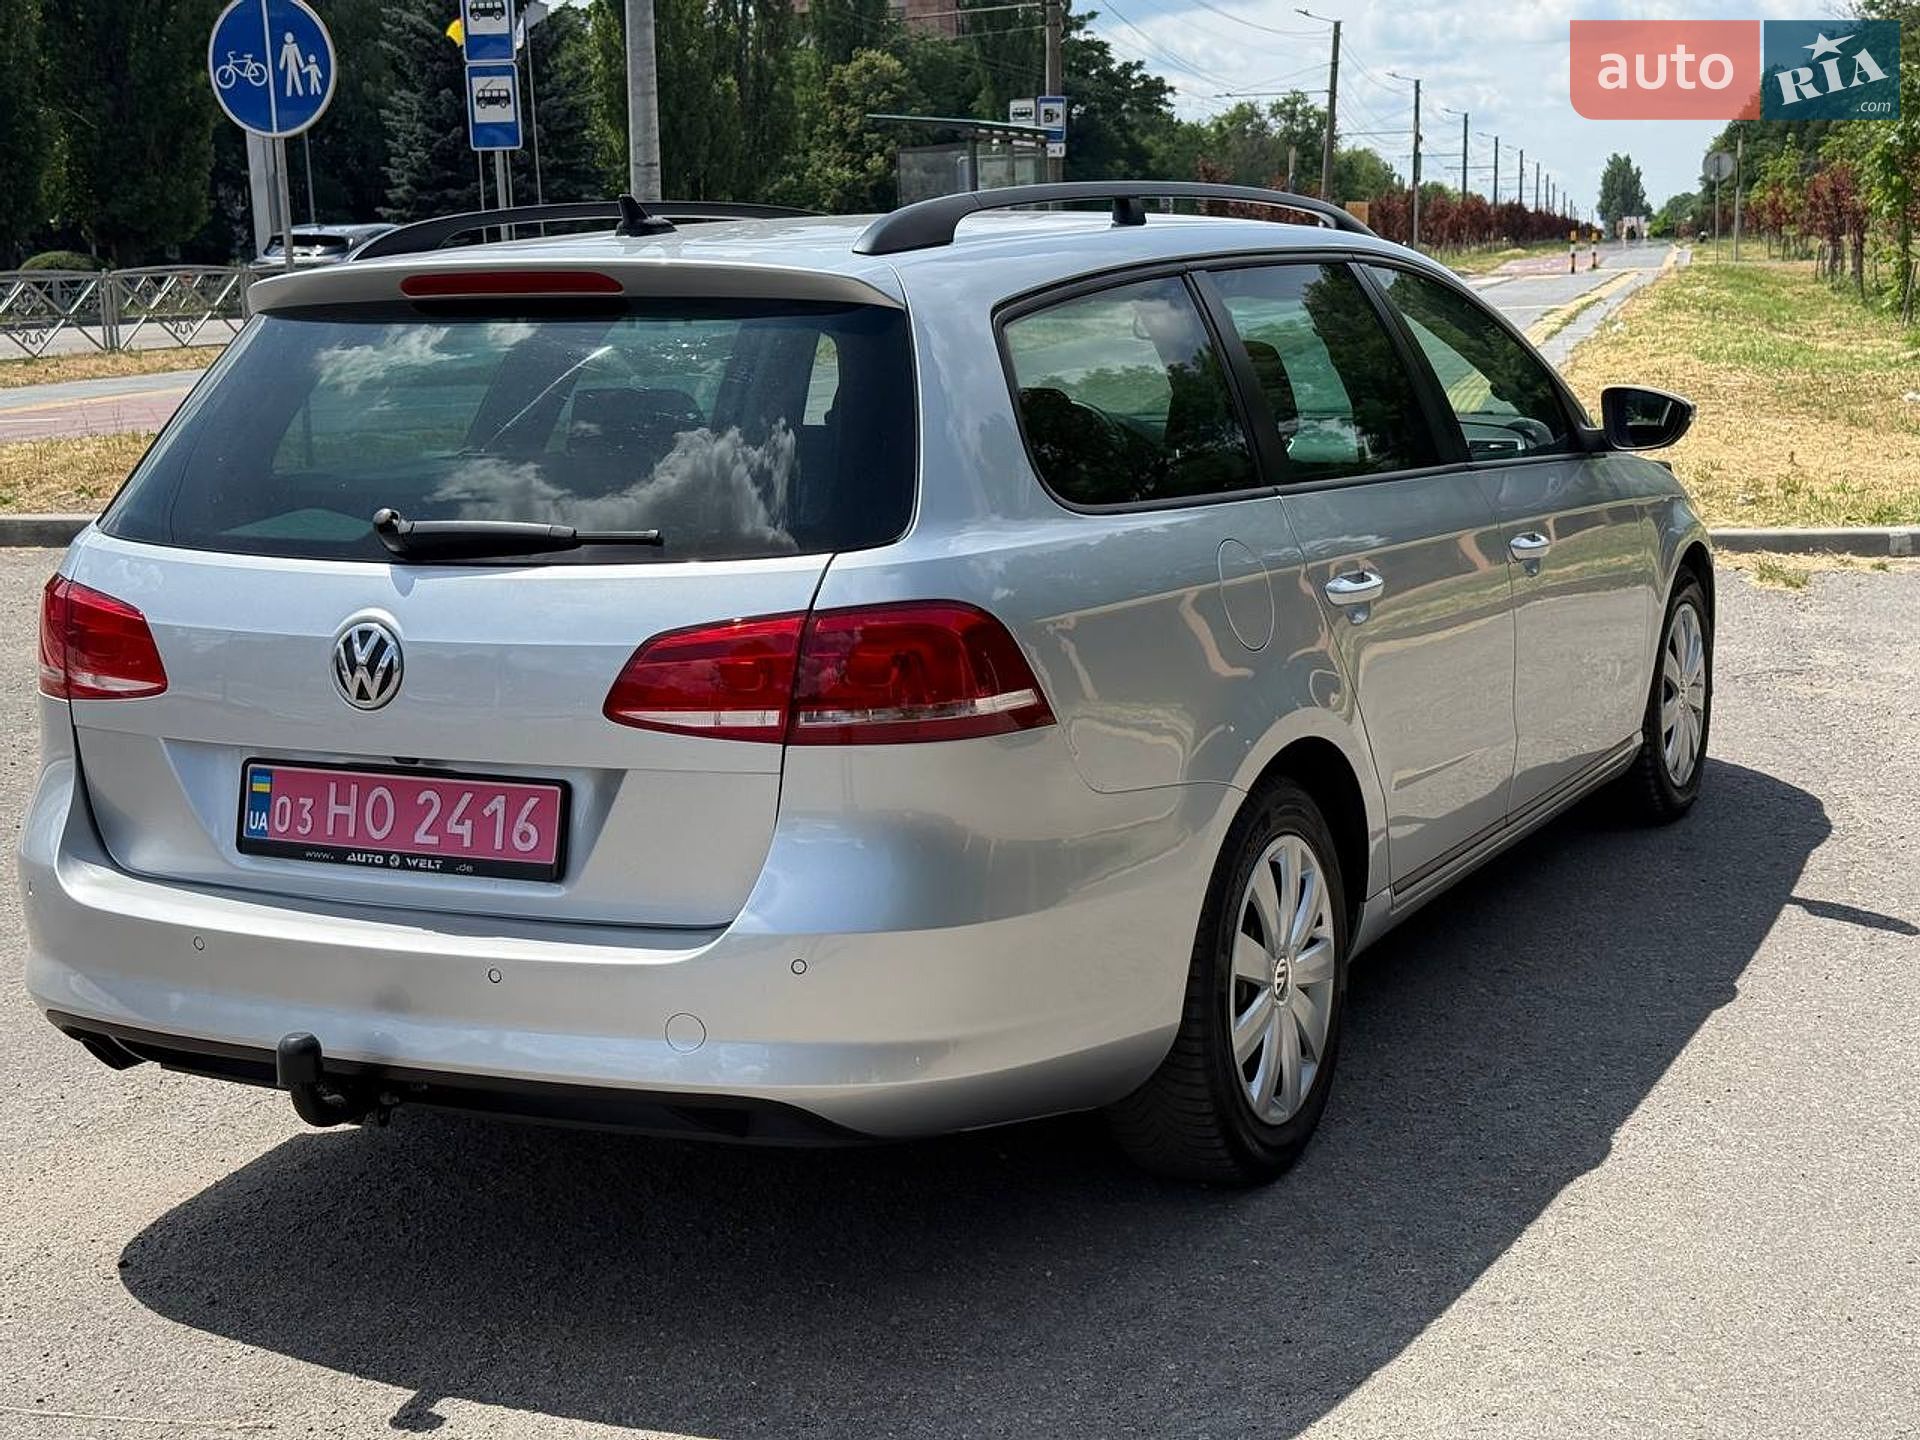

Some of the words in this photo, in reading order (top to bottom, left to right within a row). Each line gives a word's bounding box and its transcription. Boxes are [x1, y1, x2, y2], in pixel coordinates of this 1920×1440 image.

[249, 811, 268, 831] UA
[274, 795, 315, 835] 03
[326, 781, 395, 840] HO
[413, 789, 541, 852] 2416
[346, 852, 384, 864] AUTO
[406, 857, 443, 870] WELT
